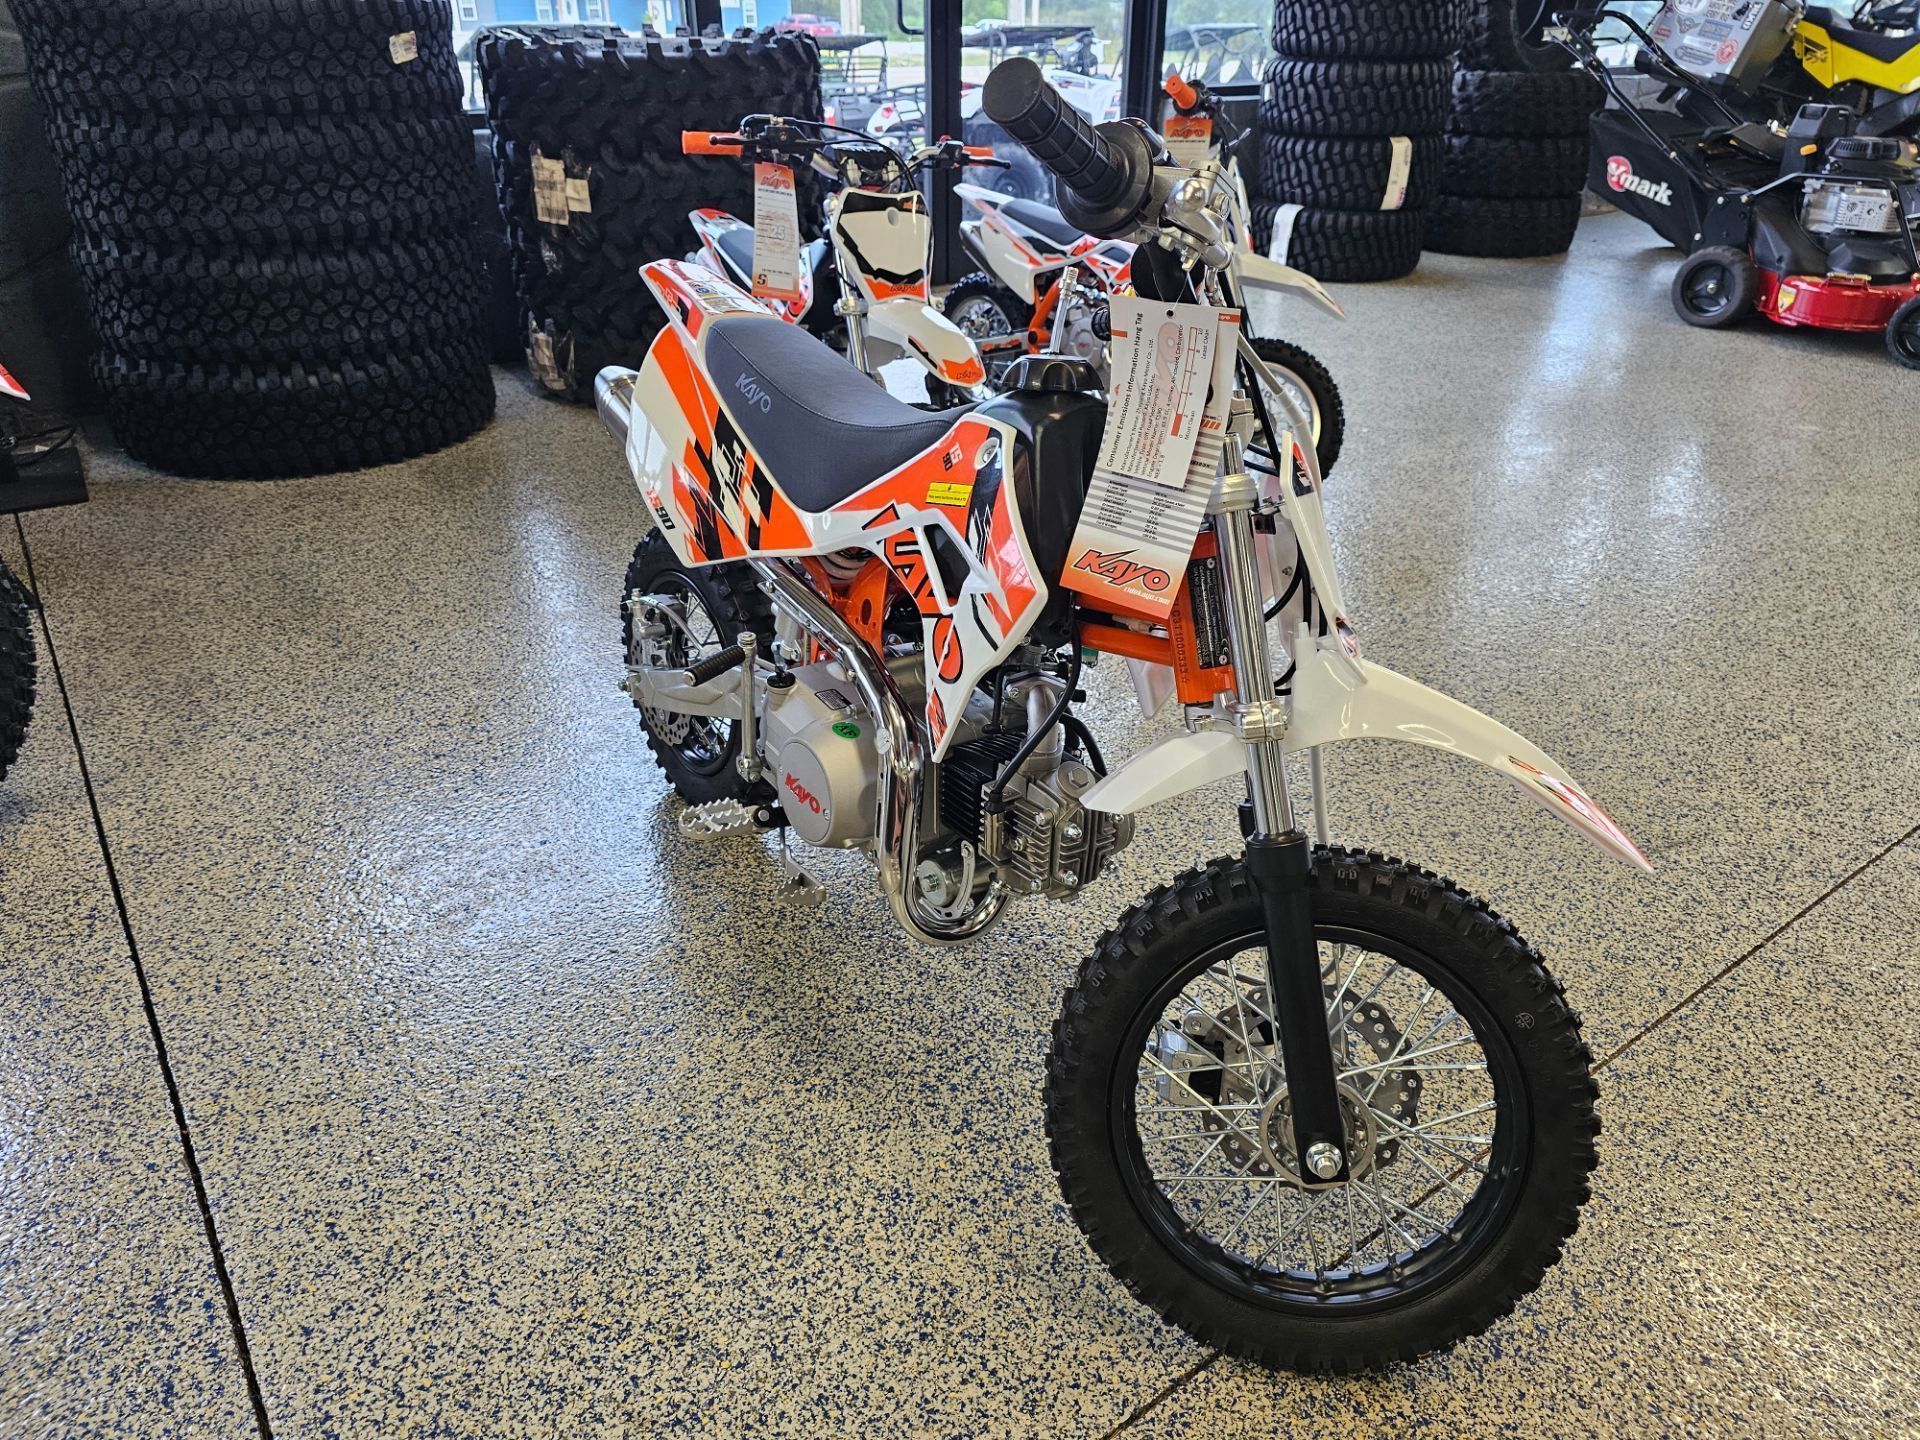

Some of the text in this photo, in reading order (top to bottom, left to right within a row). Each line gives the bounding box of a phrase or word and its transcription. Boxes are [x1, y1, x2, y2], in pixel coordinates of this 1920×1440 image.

[1133, 327, 1144, 347] Hang
[1135, 312, 1144, 325] Tag
[1175, 324, 1183, 355] Carburetor
[1126, 347, 1140, 393] Information
[735, 372, 772, 414] KAYO
[1117, 393, 1132, 430] Emissions
[942, 452, 953, 472] 90
[1106, 430, 1122, 468] Consumer
[1073, 548, 1171, 592] KAYO
[1123, 586, 1171, 605] ridekayo.com
[784, 772, 821, 814] KAYO
